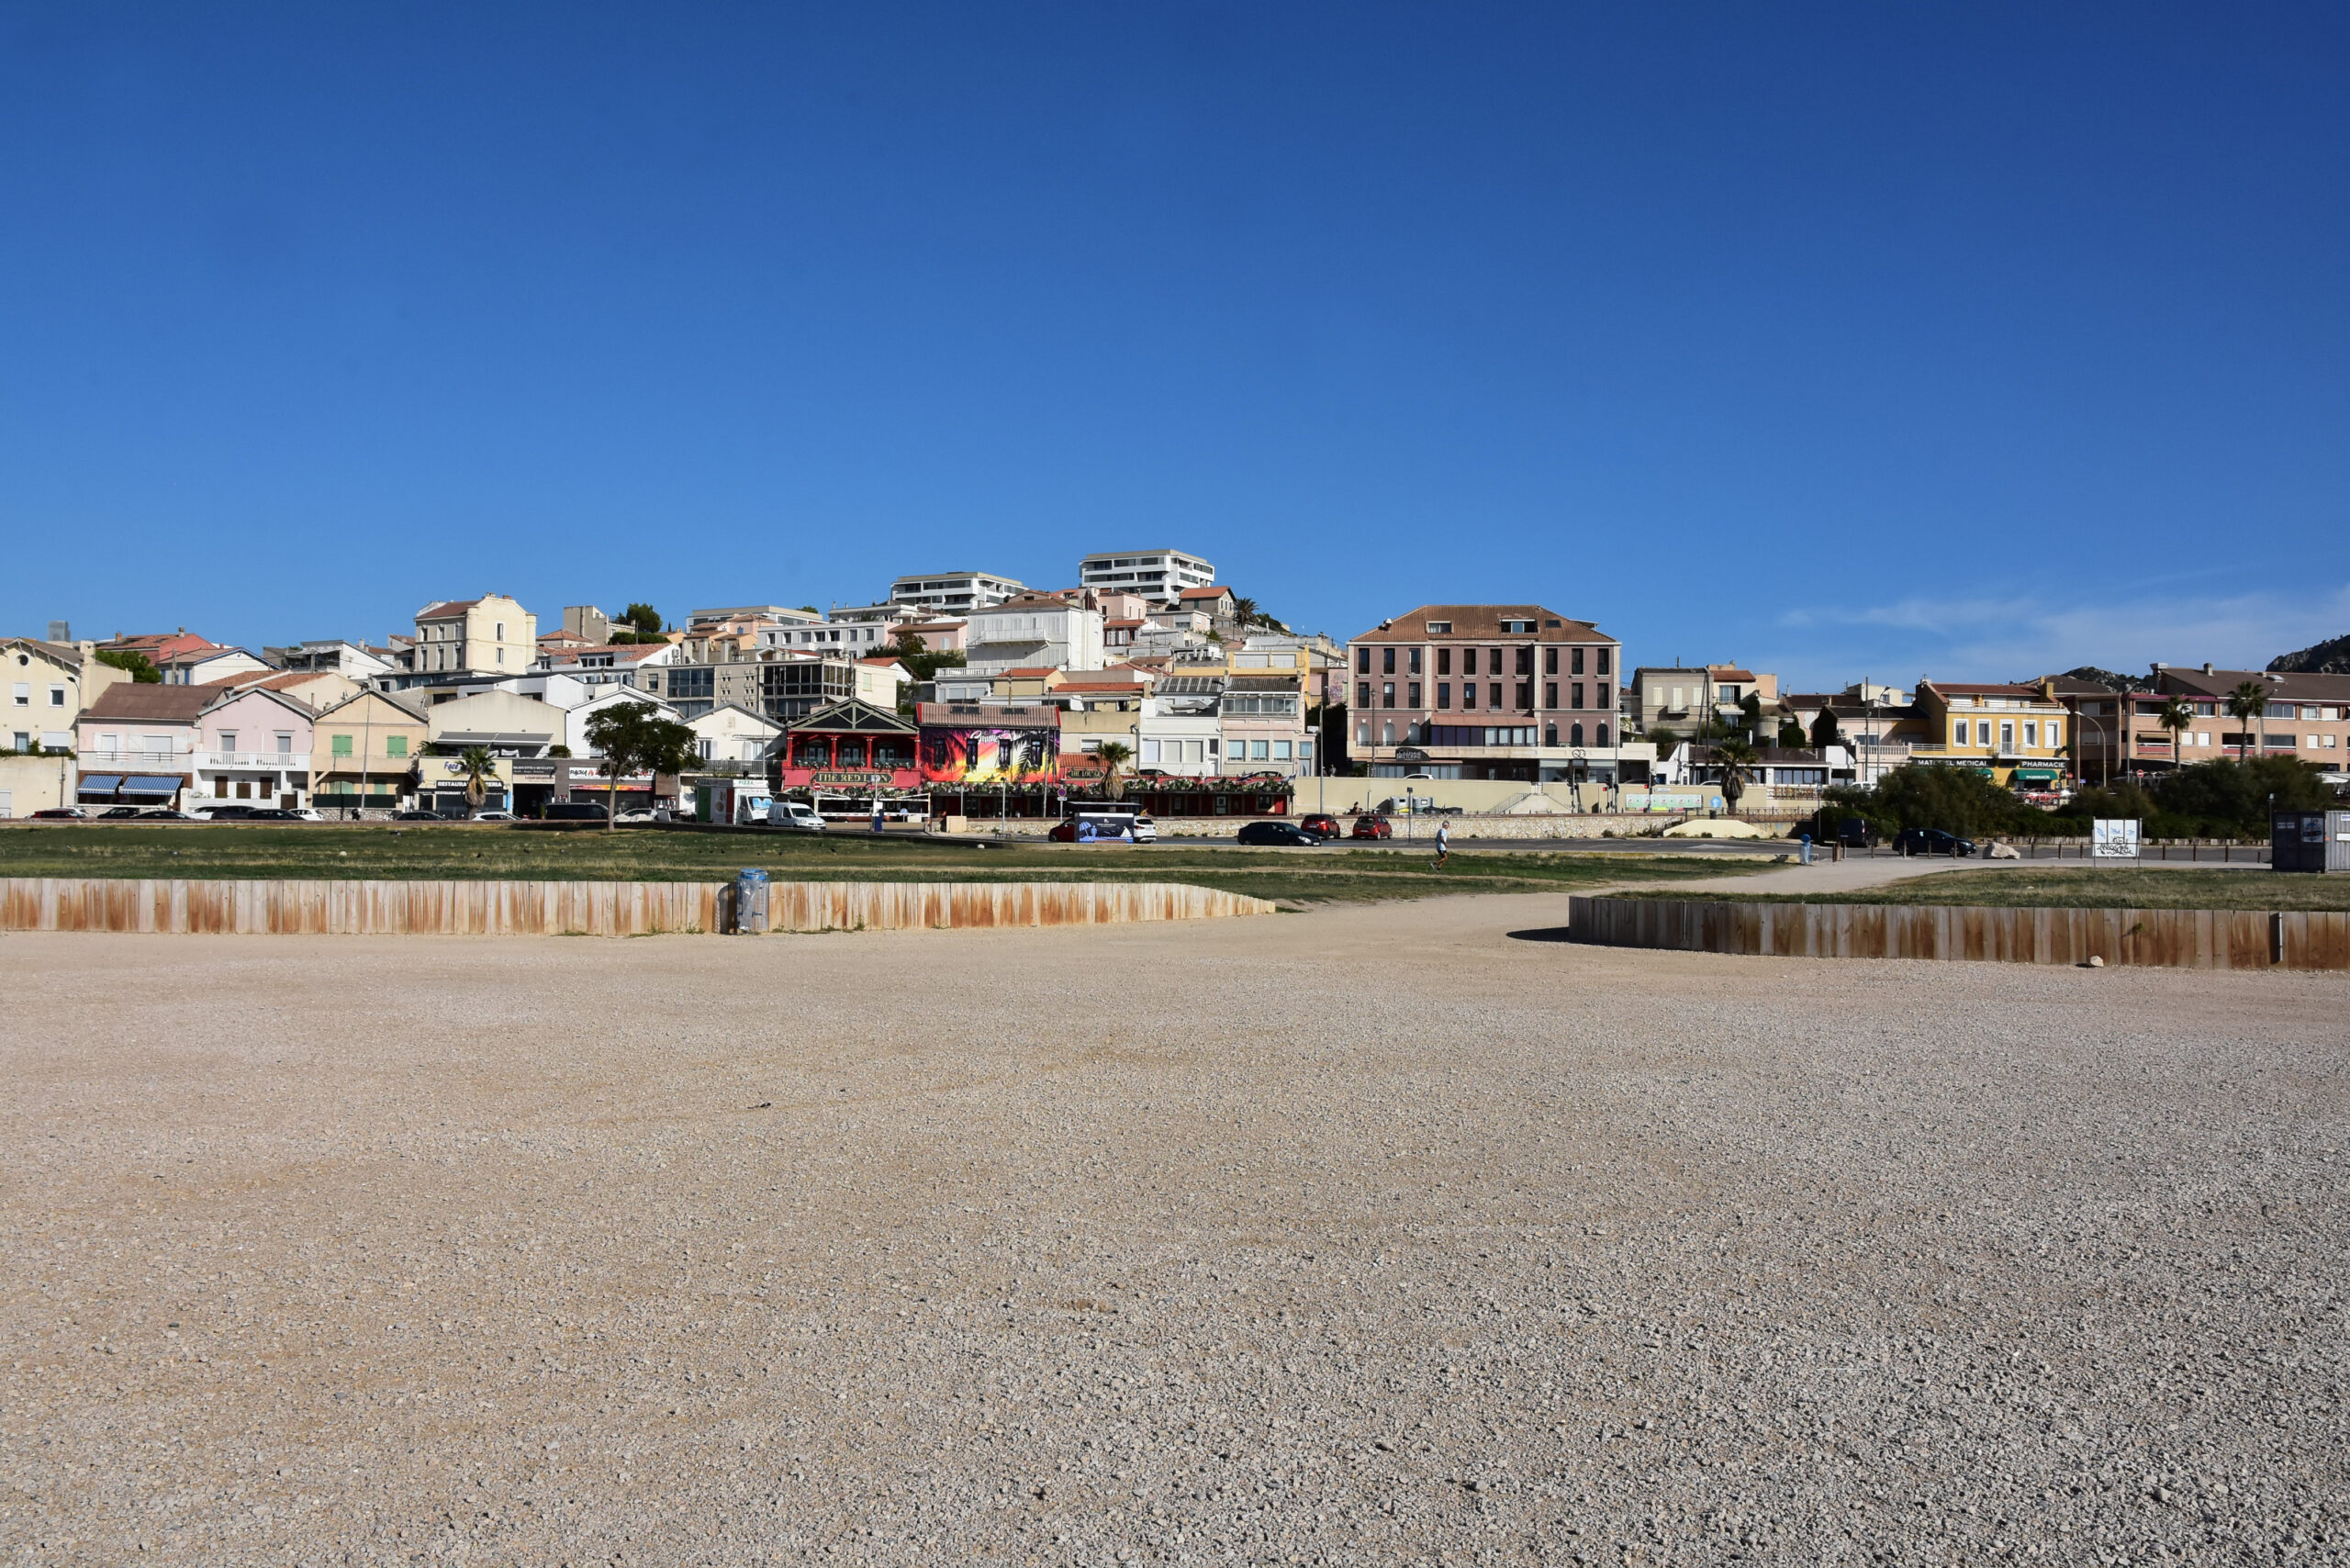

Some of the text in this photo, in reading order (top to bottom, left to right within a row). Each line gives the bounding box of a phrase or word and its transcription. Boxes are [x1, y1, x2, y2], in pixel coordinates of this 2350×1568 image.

[1956, 759, 1987, 767] MEDICAL
[2021, 760, 2065, 768] PHARMACIE
[819, 773, 888, 782] THE RED LN
